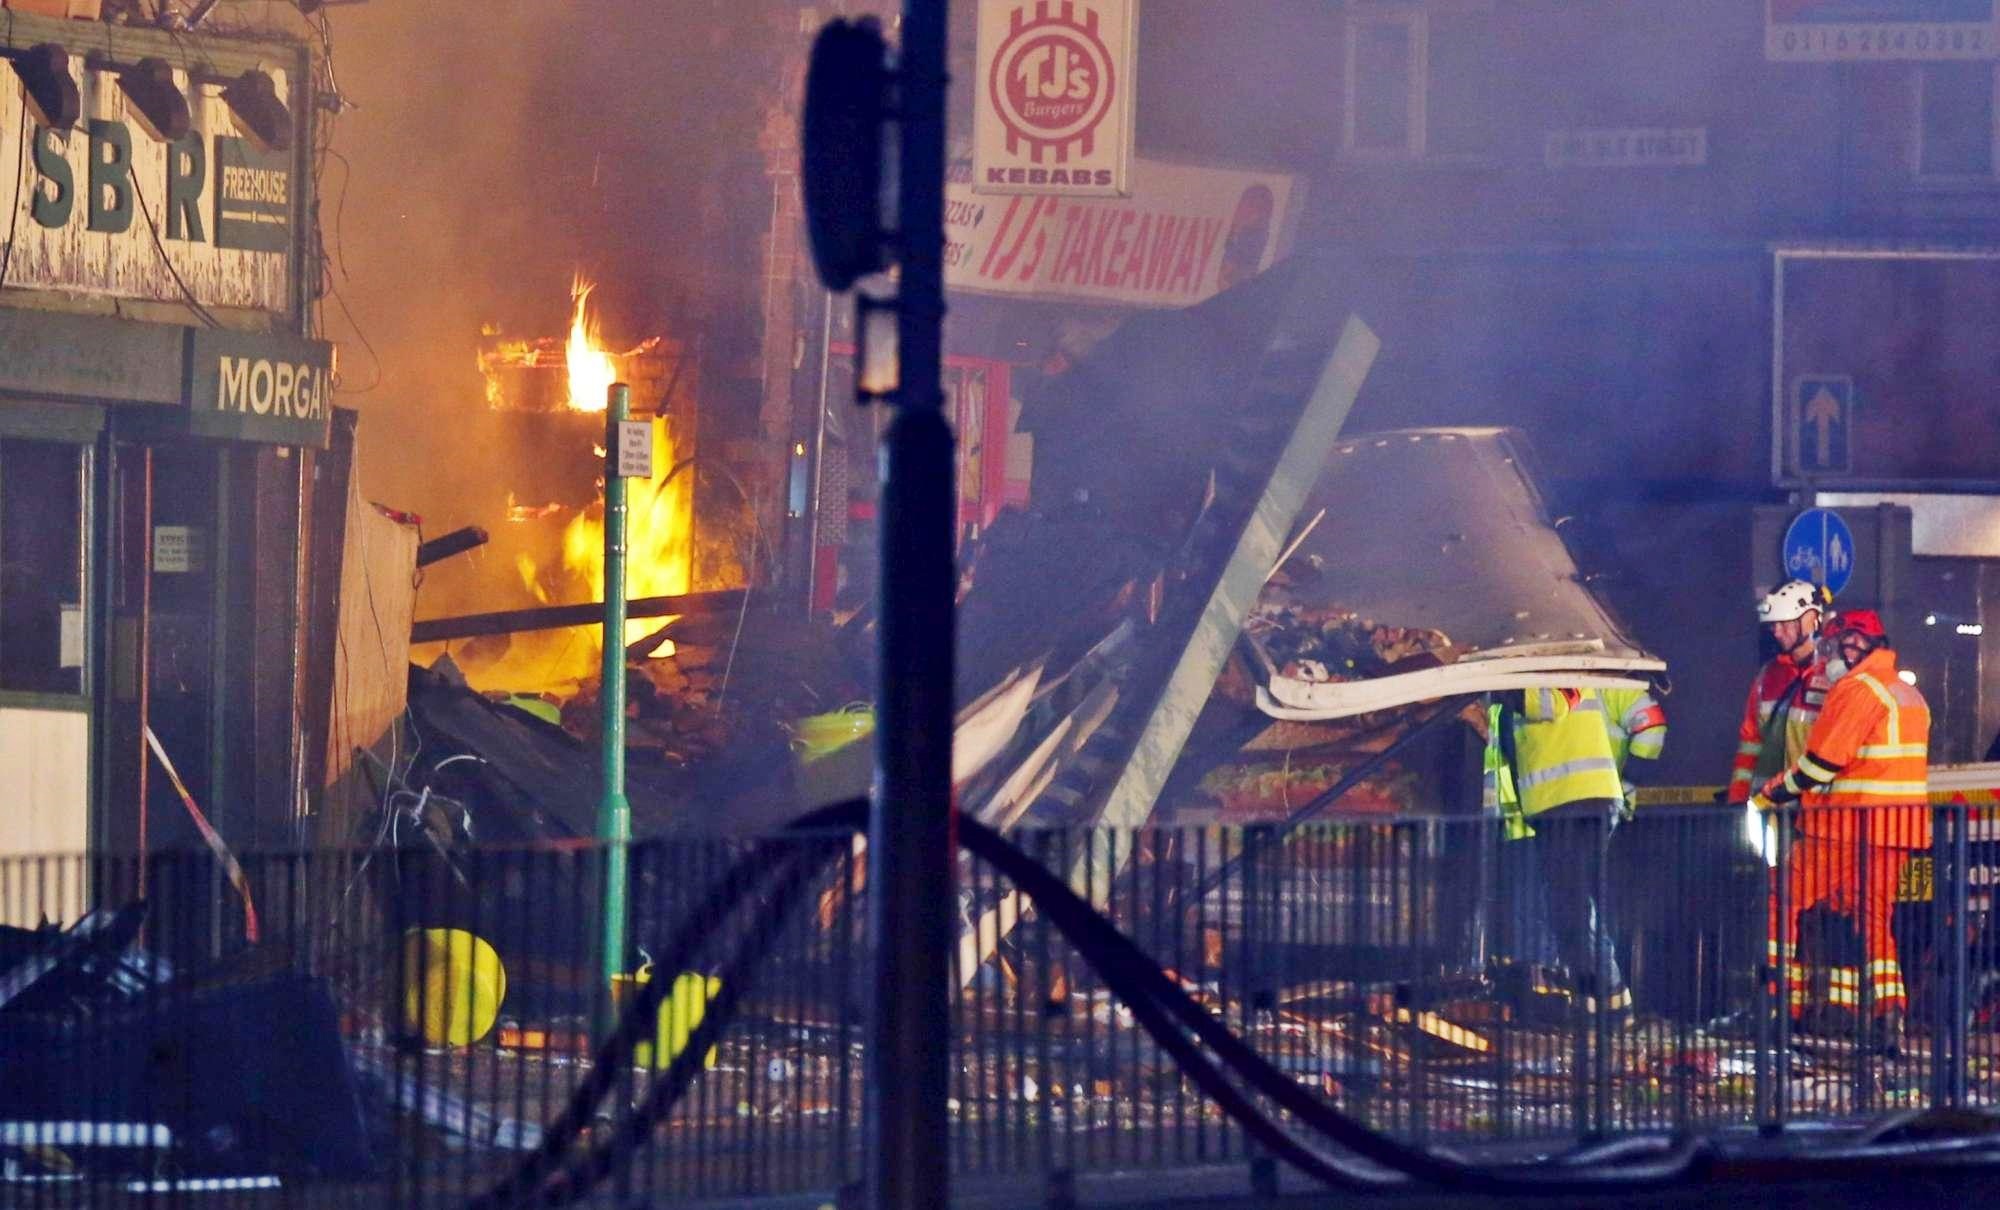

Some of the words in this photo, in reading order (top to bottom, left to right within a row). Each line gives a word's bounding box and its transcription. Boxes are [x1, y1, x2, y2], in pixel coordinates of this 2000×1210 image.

[1023, 101, 1084, 119] Burgers
[223, 166, 287, 204] FREEHOUSE
[987, 168, 1112, 186] KEBABS
[1050, 205, 1223, 292] TAKEAWAY
